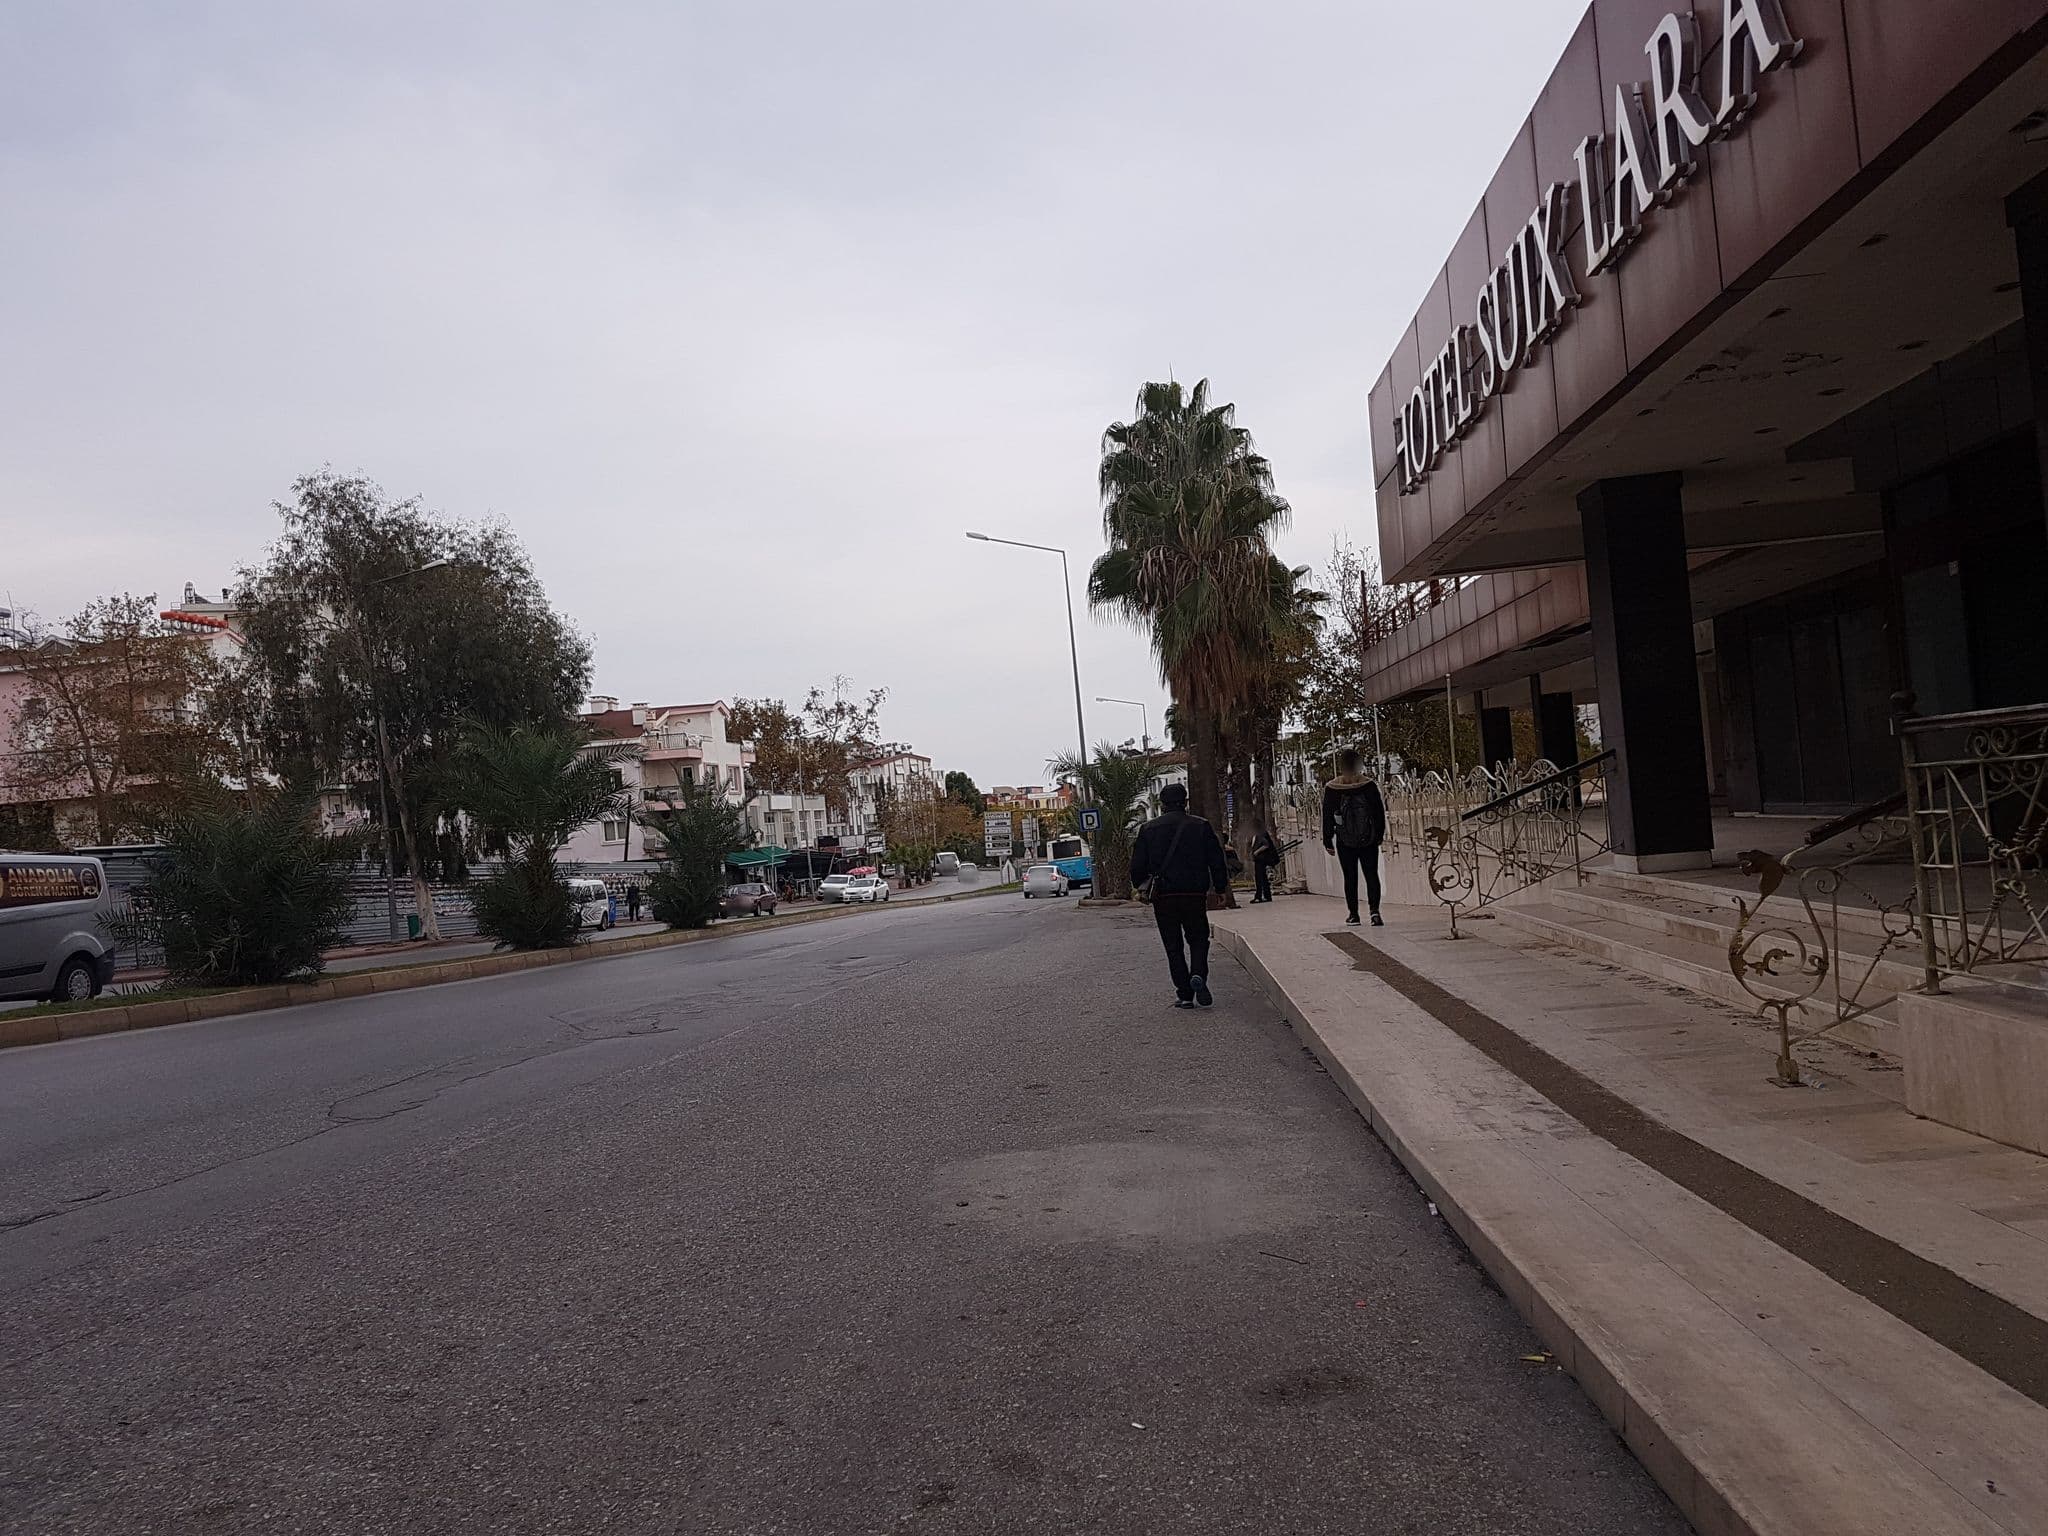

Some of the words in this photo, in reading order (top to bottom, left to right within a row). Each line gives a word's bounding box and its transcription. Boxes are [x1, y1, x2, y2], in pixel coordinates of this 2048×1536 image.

[1395, 325, 1473, 486] HOTEL
[1573, 0, 1780, 277] LARA
[1085, 814, 1095, 826] D
